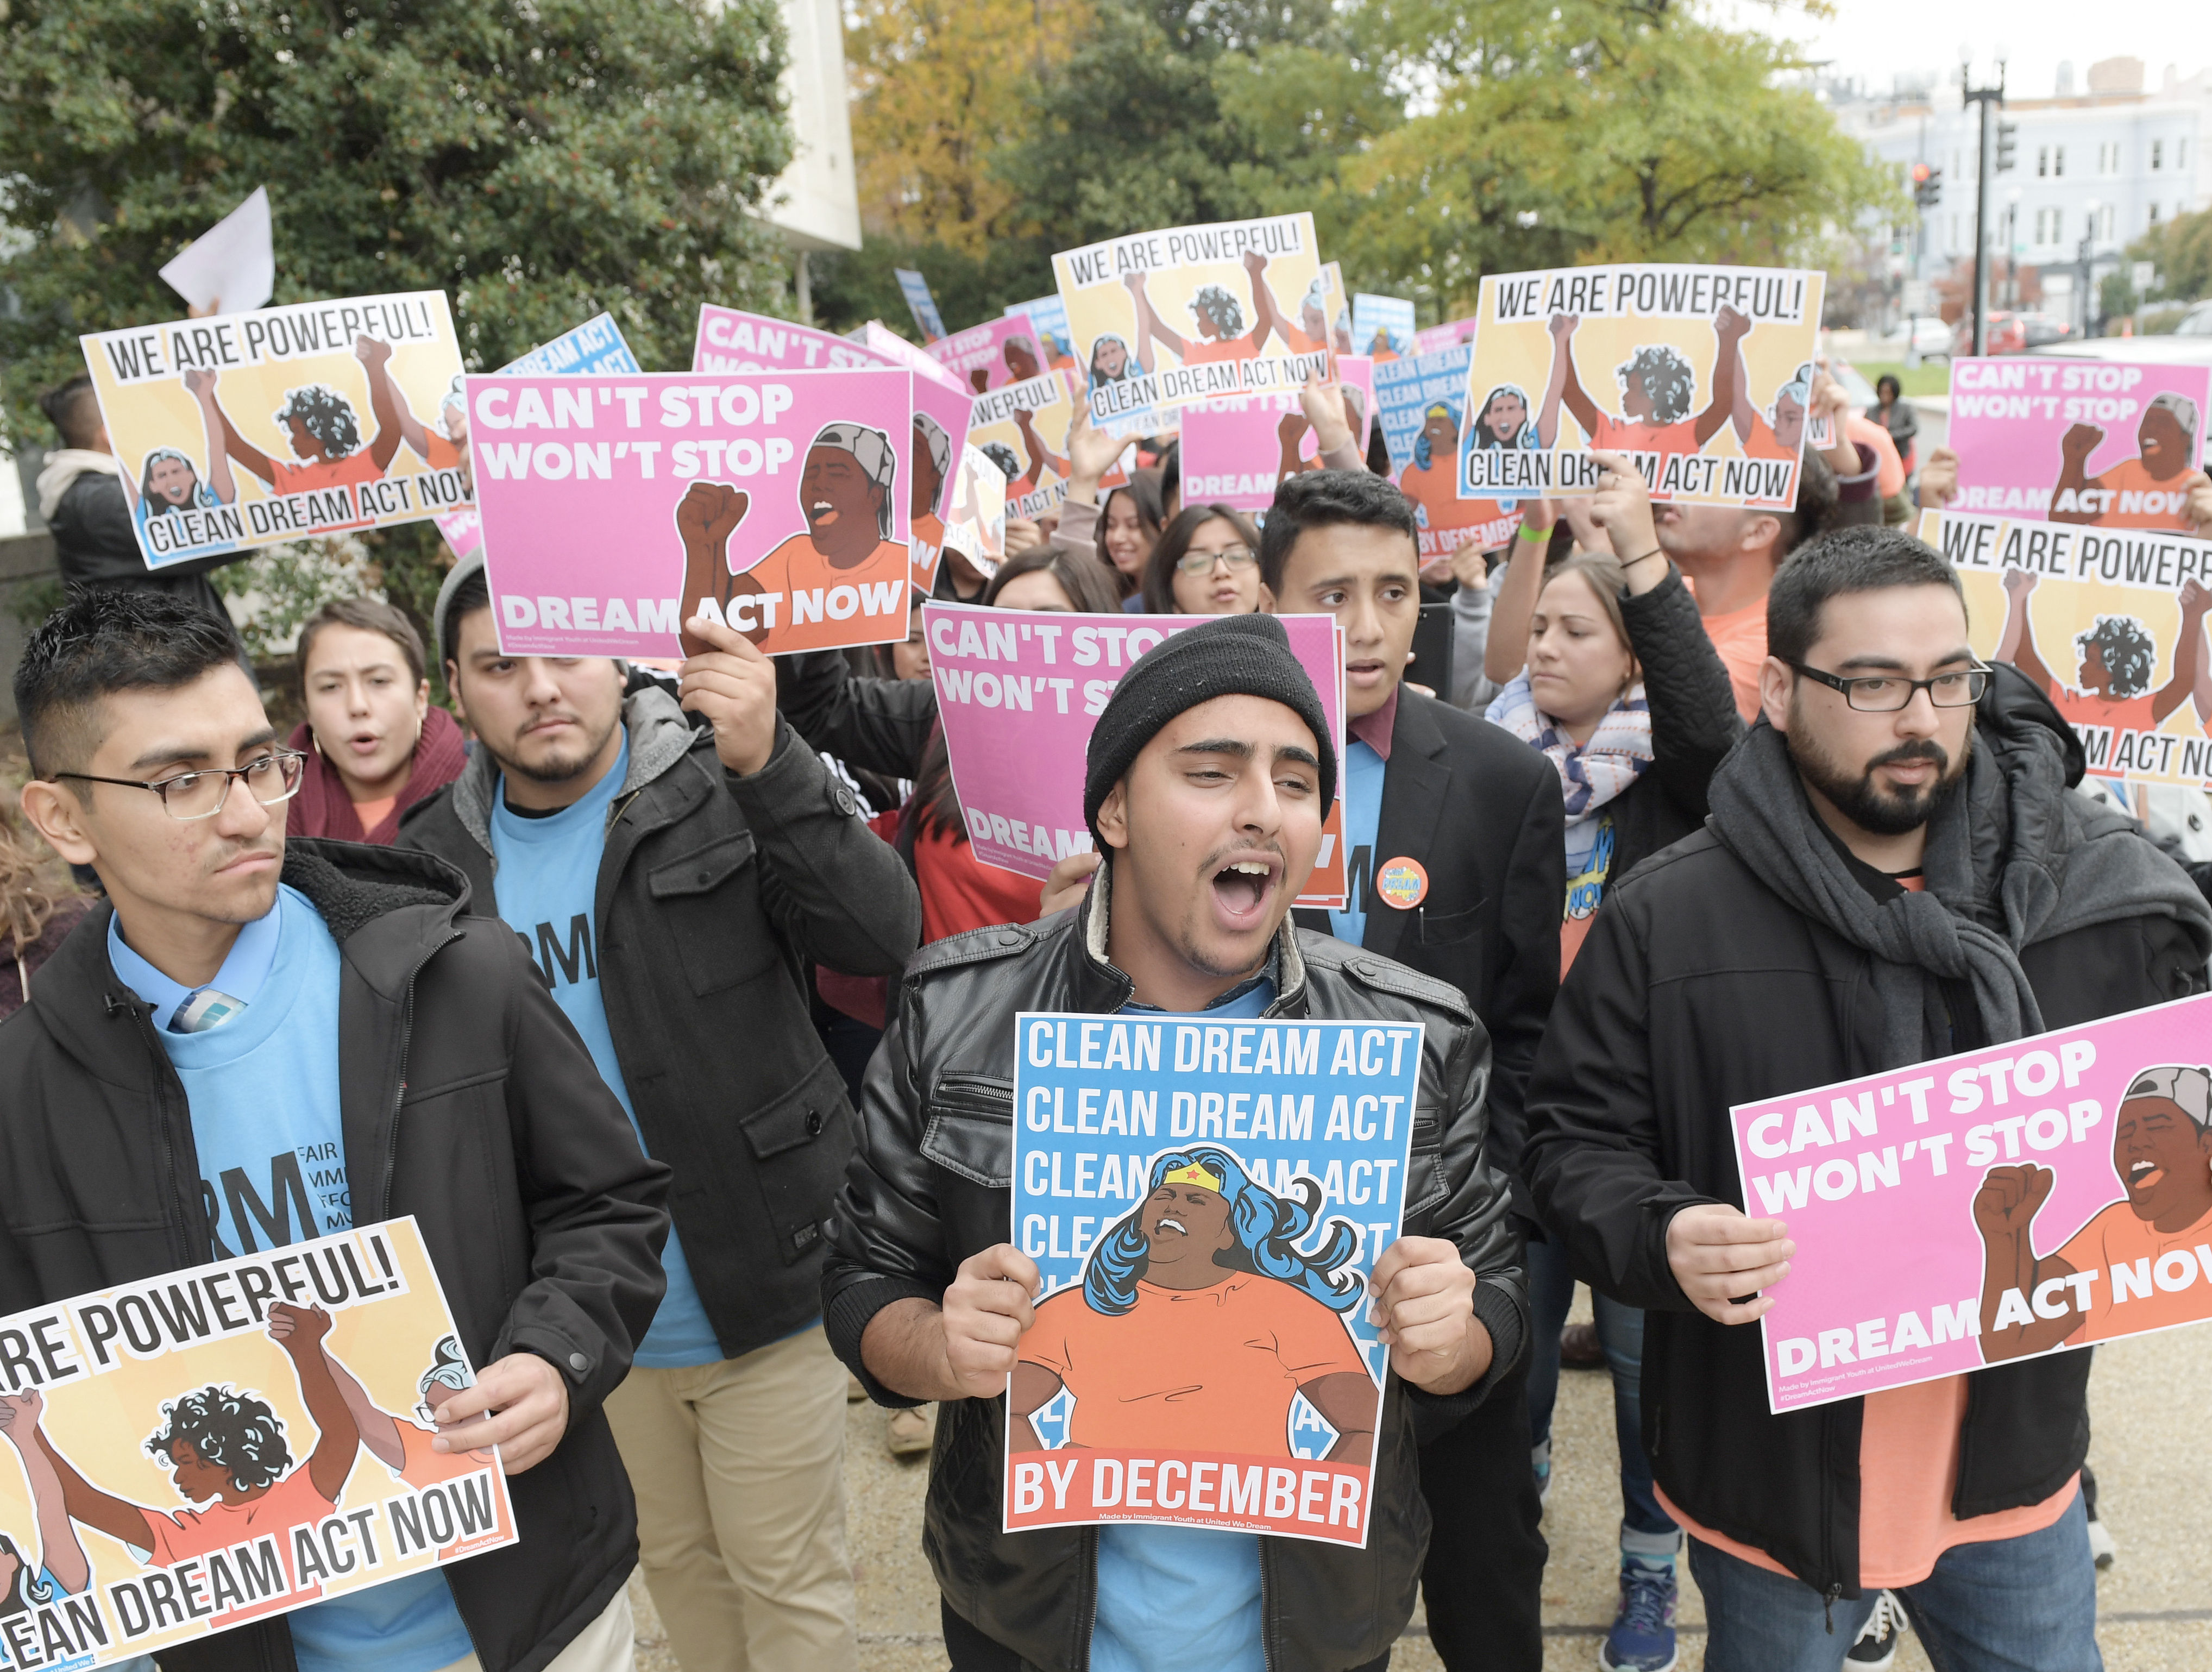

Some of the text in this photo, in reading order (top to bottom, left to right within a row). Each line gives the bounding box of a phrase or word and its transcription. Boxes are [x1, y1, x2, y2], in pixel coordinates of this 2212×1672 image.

[1070, 221, 1299, 285] WE ARE POWERFUL!
[1498, 273, 1801, 319] WE ARE POWERFUL!
[107, 301, 432, 379] WE ARE POWERFUL!
[576, 317, 614, 356] ACT
[706, 316, 824, 367] CAN'T
[1093, 376, 1158, 418] CLEAN
[1164, 366, 1238, 398] DREAM
[1243, 360, 1278, 392] ACT
[1283, 353, 1328, 382] NOW
[1957, 365, 2142, 392] CAN'T STOP
[475, 384, 794, 429] CAN'T STOP
[1958, 395, 2138, 422] WON'T STOP
[479, 438, 794, 480] WON'T STOP
[1469, 452, 1789, 496] CLEAN DRM ACT NOW
[1023, 490, 1051, 513] ACT
[1186, 473, 1277, 497] DREAM
[2055, 488, 2116, 513] ACT
[148, 507, 243, 552] CLEAN
[248, 491, 354, 536] DREAM
[361, 482, 408, 517] ACT
[1944, 520, 1995, 566] WE
[2002, 529, 2070, 574] ARE
[501, 580, 904, 634] DREAM ACT NOW
[931, 618, 1165, 667] CAN'T STO
[937, 667, 1074, 714] WON'T
[2115, 733, 2176, 772] ACT
[967, 807, 1094, 862] DREAM
[1028, 1021, 1411, 1076] CLEAN DREAM ACT
[1026, 1086, 1404, 1141] CLEAN DREAM ACT
[1747, 1039, 2098, 1159] CAN'T STOP
[298, 1142, 338, 1162] FAIR
[1752, 1098, 2103, 1215] WON'T STOP
[1322, 1160, 1397, 1205] ACT
[78, 1235, 400, 1366] POWERFUL!
[1776, 1298, 1982, 1378] DREAM
[1994, 1269, 2099, 1331] ACT
[1779, 1383, 1799, 1393] Made
[1810, 1373, 1845, 1386] Immigrant
[1846, 1369, 1866, 1378] Youth
[1014, 1459, 1363, 1530] BY DECEMBER
[455, 1535, 504, 1554] #DreamActNow
[1174, 1515, 1195, 1523] Youth
[1205, 1518, 1230, 1527] United
[1246, 1522, 1272, 1531] Dream
[111, 1540, 285, 1638] DREAM
[294, 1508, 380, 1588] ACT
[389, 1475, 494, 1556] NOW
